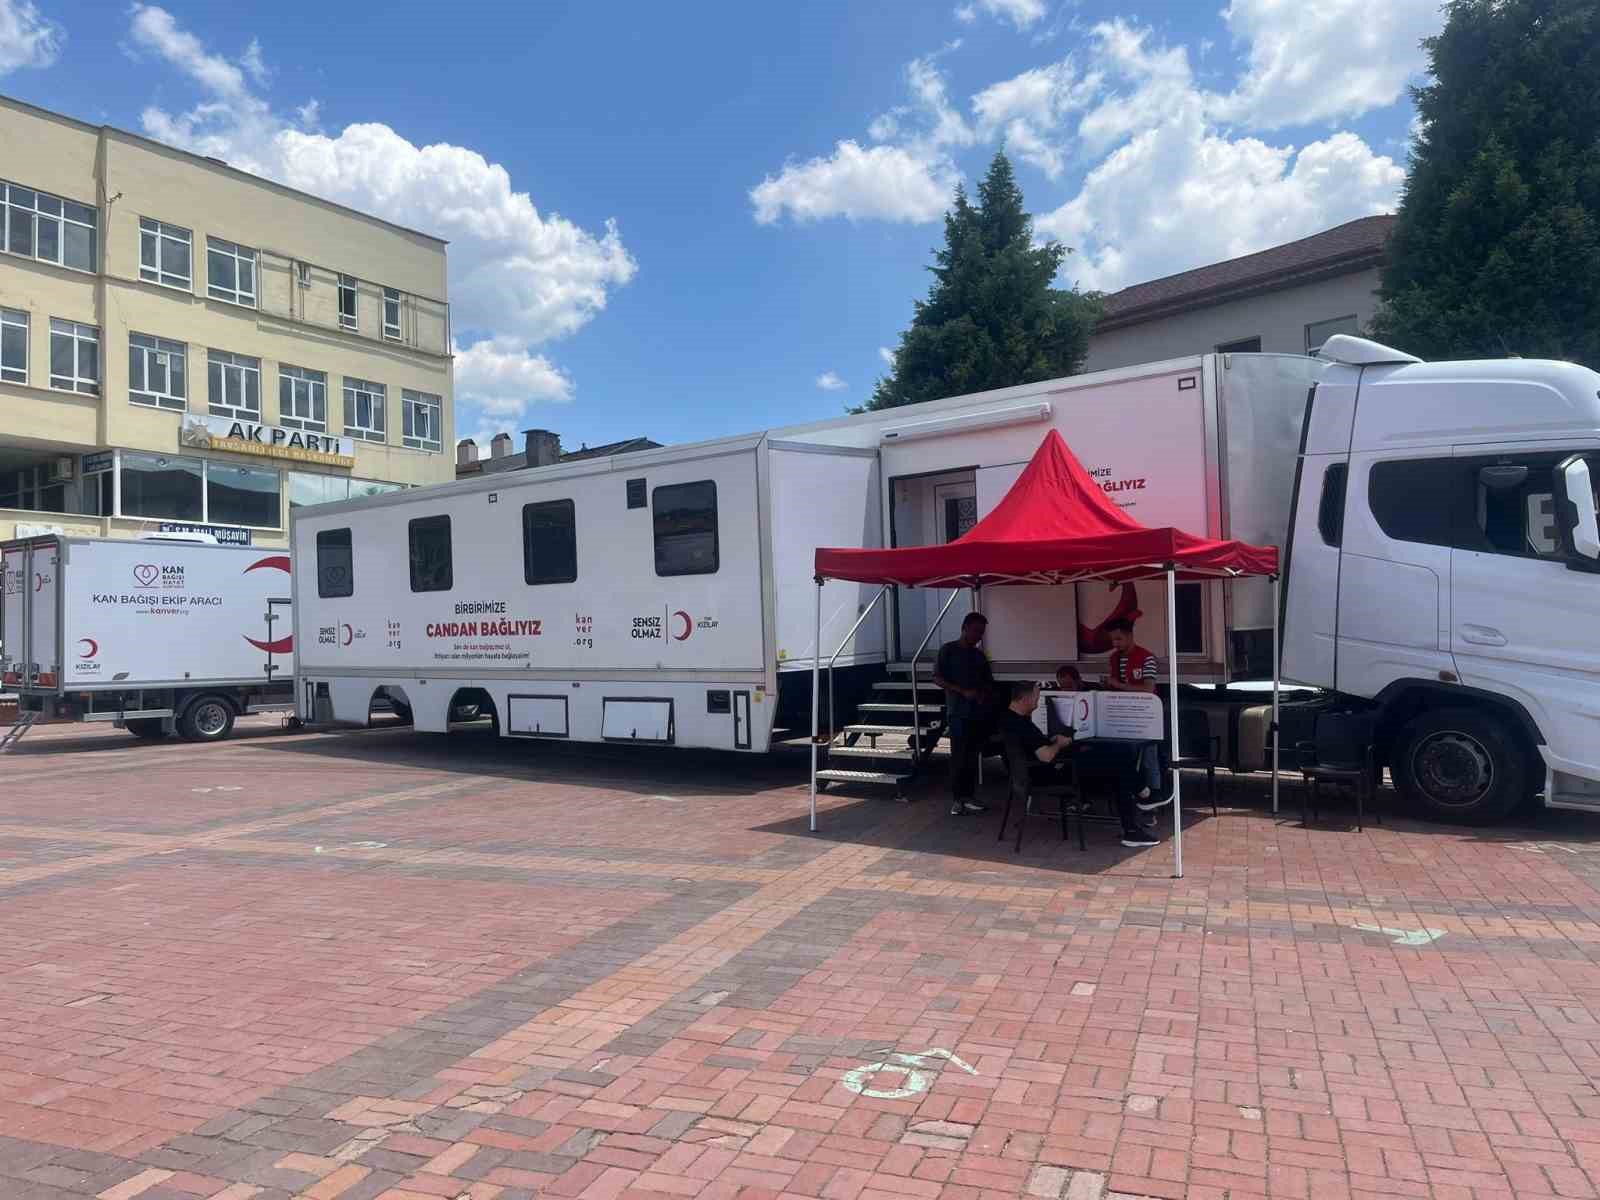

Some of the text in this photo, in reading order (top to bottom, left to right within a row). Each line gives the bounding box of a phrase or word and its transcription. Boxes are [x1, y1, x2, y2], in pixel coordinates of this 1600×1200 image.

[229, 422, 263, 443] AK
[1097, 479, 1146, 492] ĞLIYIZ
[162, 566, 184, 574] KAN
[93, 594, 118, 604] KAN
[161, 595, 187, 605] EKİP
[189, 596, 223, 606] ARACI
[455, 600, 506, 614] BİRBİRİMİZE
[426, 617, 542, 637] CANDAN BAĞLIYIZ
[632, 616, 661, 627] SENSİZ
[631, 628, 661, 639] OLMAZ
